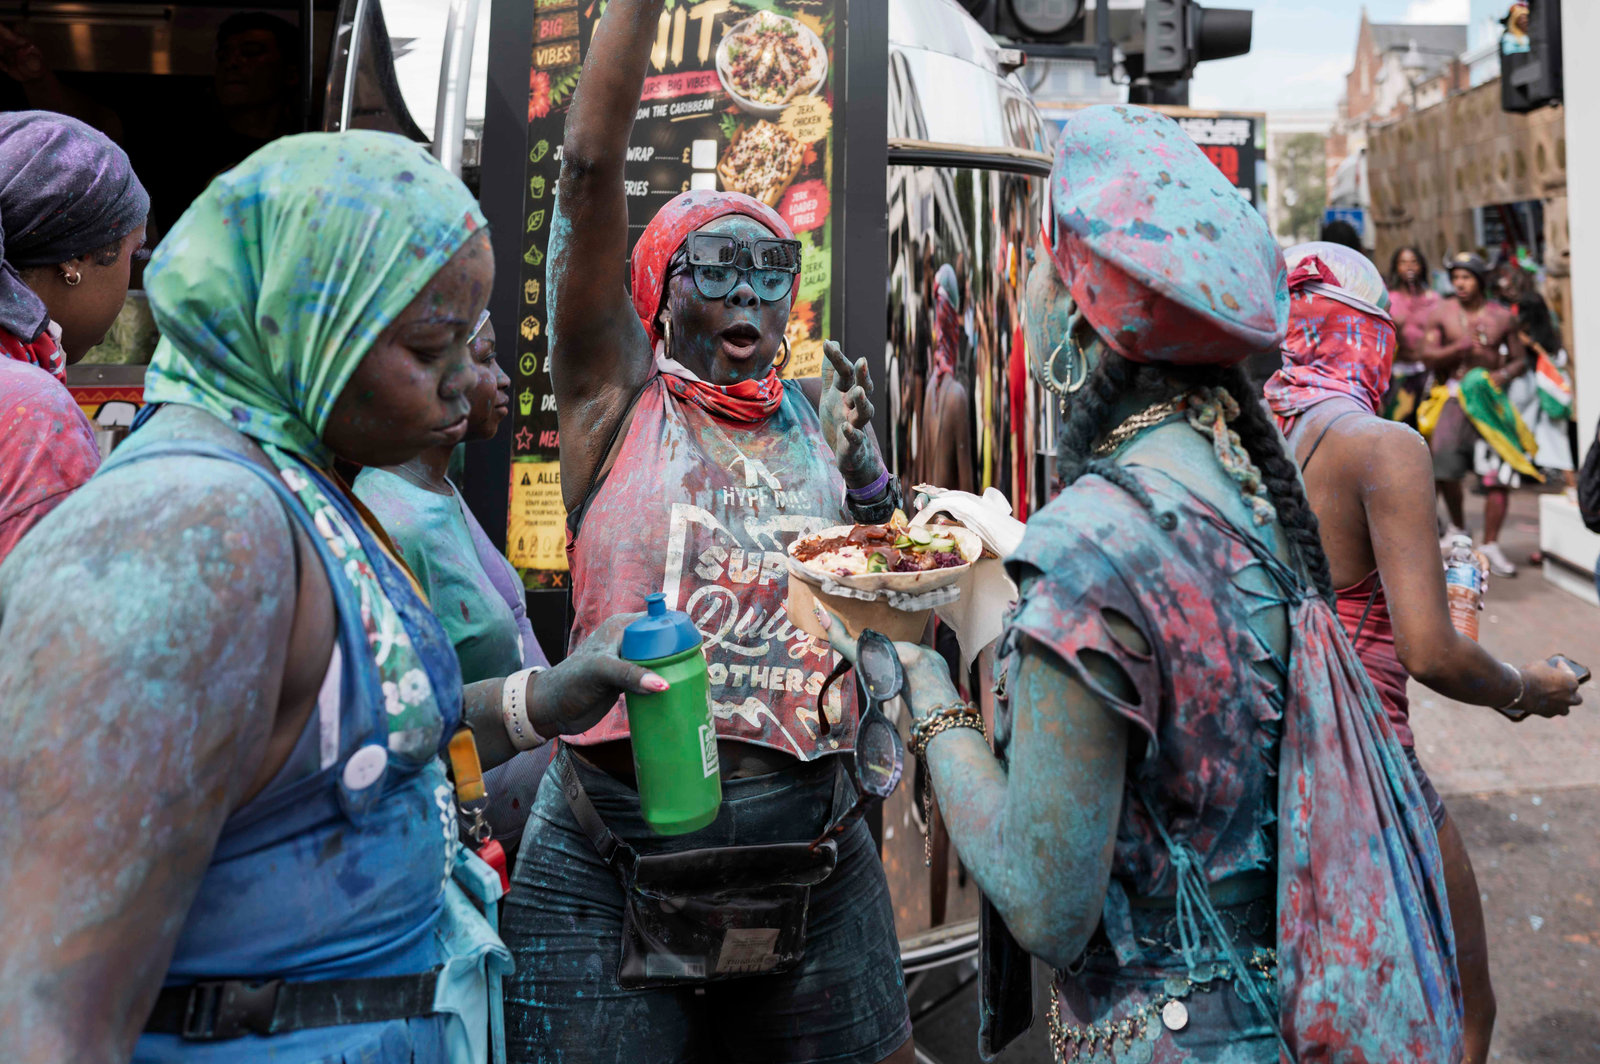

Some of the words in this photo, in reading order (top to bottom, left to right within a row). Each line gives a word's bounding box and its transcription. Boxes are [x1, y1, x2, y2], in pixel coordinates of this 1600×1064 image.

[540, 17, 563, 38] BIG
[536, 45, 572, 65] VIBES
[668, 79, 682, 91] BIG
[652, 104, 668, 118] THE
[669, 98, 714, 116] CARIBBEAN
[797, 104, 814, 115] JERK
[793, 115, 821, 128] CHICKEN
[798, 127, 816, 138] BOWL
[626, 146, 655, 162] WRAP
[682, 147, 691, 163] £
[792, 191, 808, 203] JERK
[789, 200, 817, 215] LOADED
[793, 213, 815, 227] FRIES
[804, 262, 823, 274] JERK
[804, 273, 826, 287] SALAD
[794, 352, 815, 365] JERK
[793, 364, 820, 377] NACHOS
[723, 486, 769, 508] HYPE
